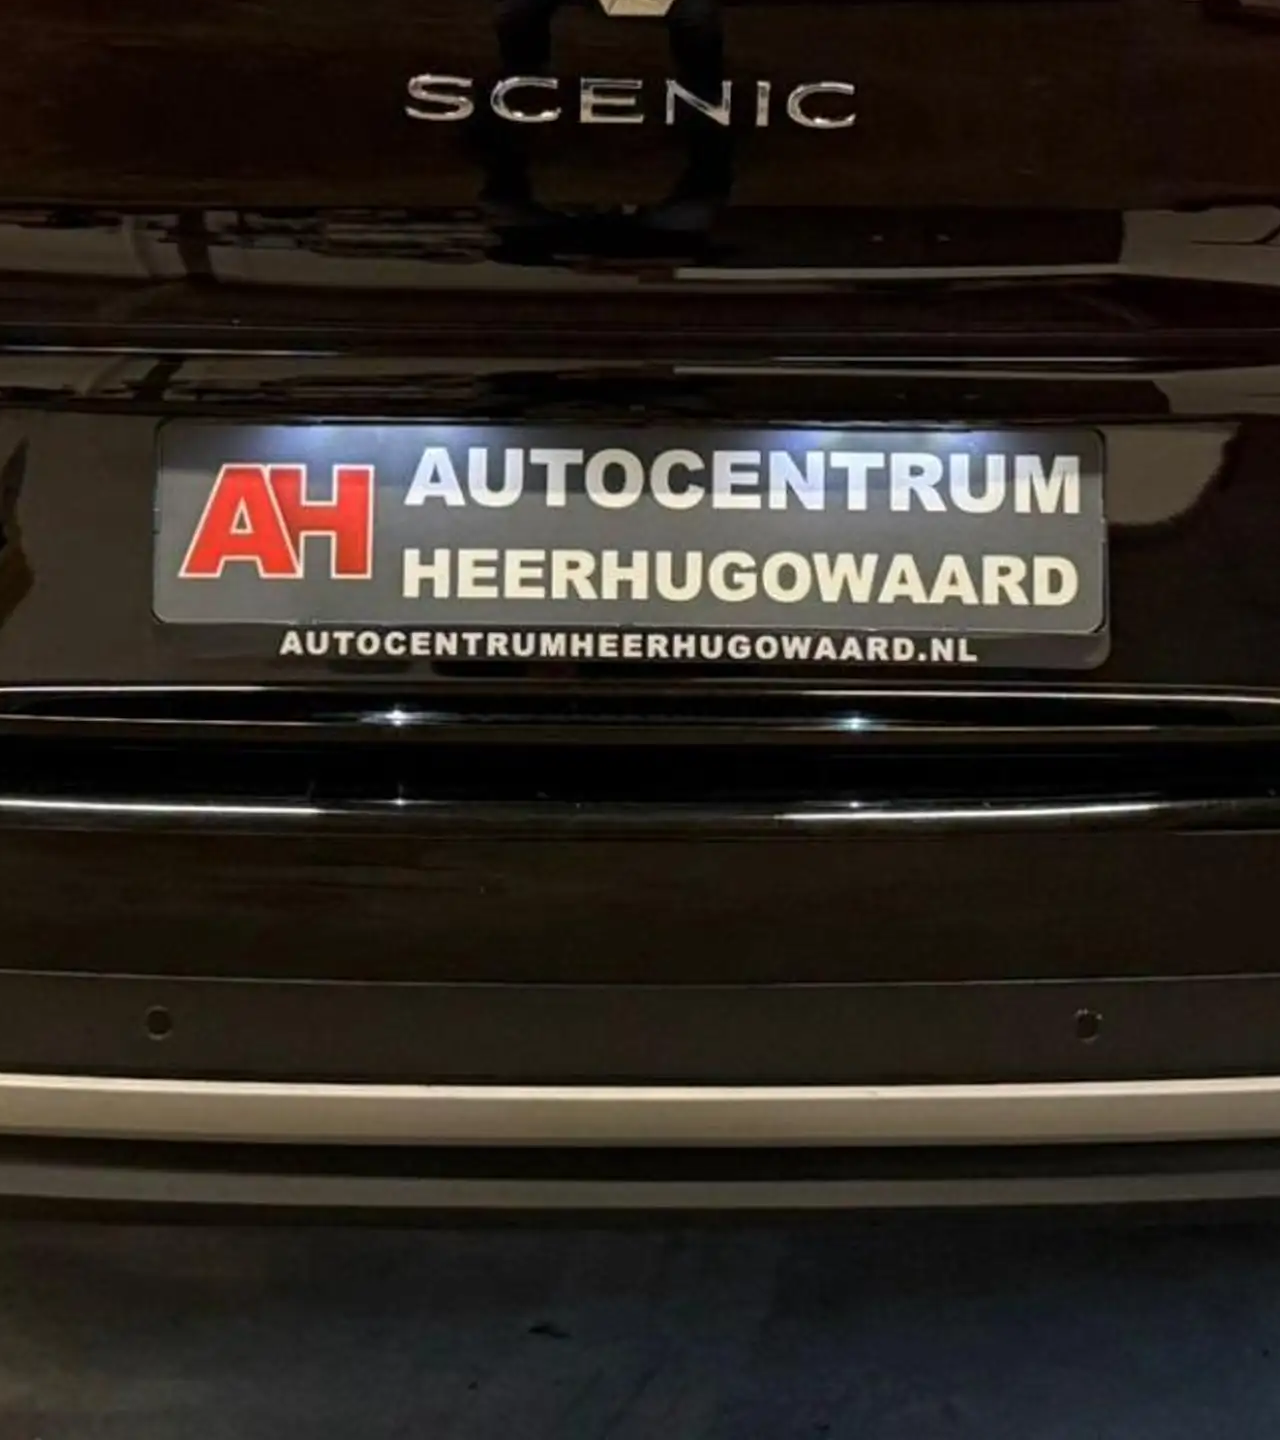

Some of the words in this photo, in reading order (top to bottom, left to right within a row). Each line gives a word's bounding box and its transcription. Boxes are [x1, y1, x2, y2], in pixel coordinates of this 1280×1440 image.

[406, 73, 856, 129] SCENIC
[404, 447, 1080, 514] AUTOCENTRUM
[178, 464, 375, 579] AH
[402, 548, 1079, 606] HEERHUGOWAARD
[280, 630, 977, 662] AUTOCENTRUMHEERHUGOWAARD.NL
